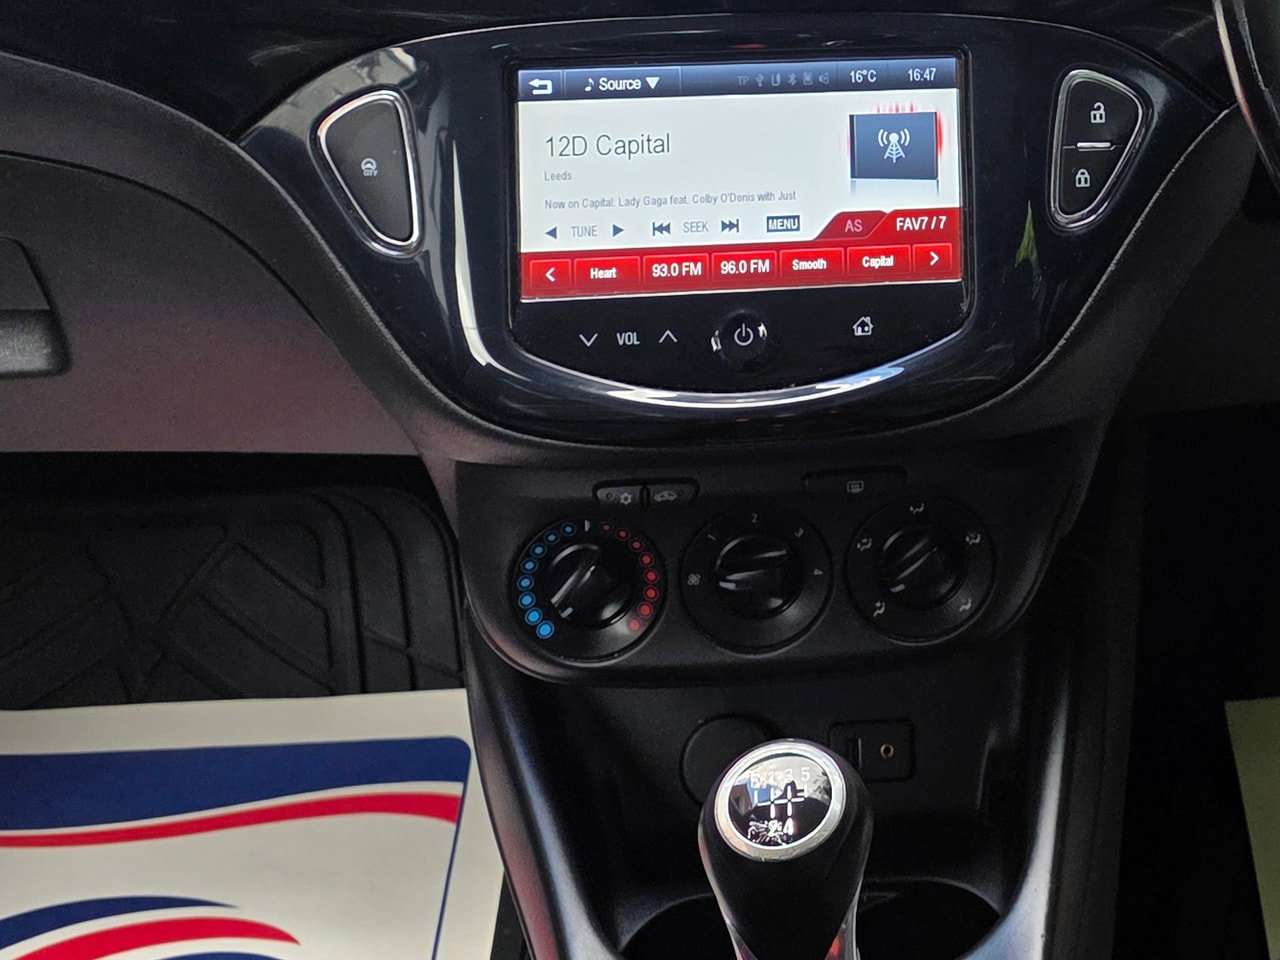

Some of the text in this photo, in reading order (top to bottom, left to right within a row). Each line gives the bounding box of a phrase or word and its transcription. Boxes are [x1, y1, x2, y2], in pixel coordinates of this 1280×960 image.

[849, 68, 877, 83] 16°C
[907, 67, 937, 82] 16:47
[599, 76, 642, 91] Source
[545, 132, 671, 160] 12D Capital
[543, 170, 572, 182] Leeds
[544, 199, 566, 209] Now
[567, 200, 580, 209] on
[617, 196, 641, 209] Lady
[642, 195, 668, 208] Gaga
[756, 190, 776, 202] with
[777, 189, 797, 201] Just
[570, 224, 599, 239] TUNE
[682, 220, 710, 234] SEEK
[768, 217, 799, 231] MENU
[844, 218, 863, 233] AS
[651, 261, 702, 278] 93.0 FM
[719, 258, 770, 275] 96.0 FM
[791, 257, 827, 271] Smooth
[862, 255, 895, 269] Capital
[589, 267, 617, 280] Heart
[616, 331, 641, 346] VOL
